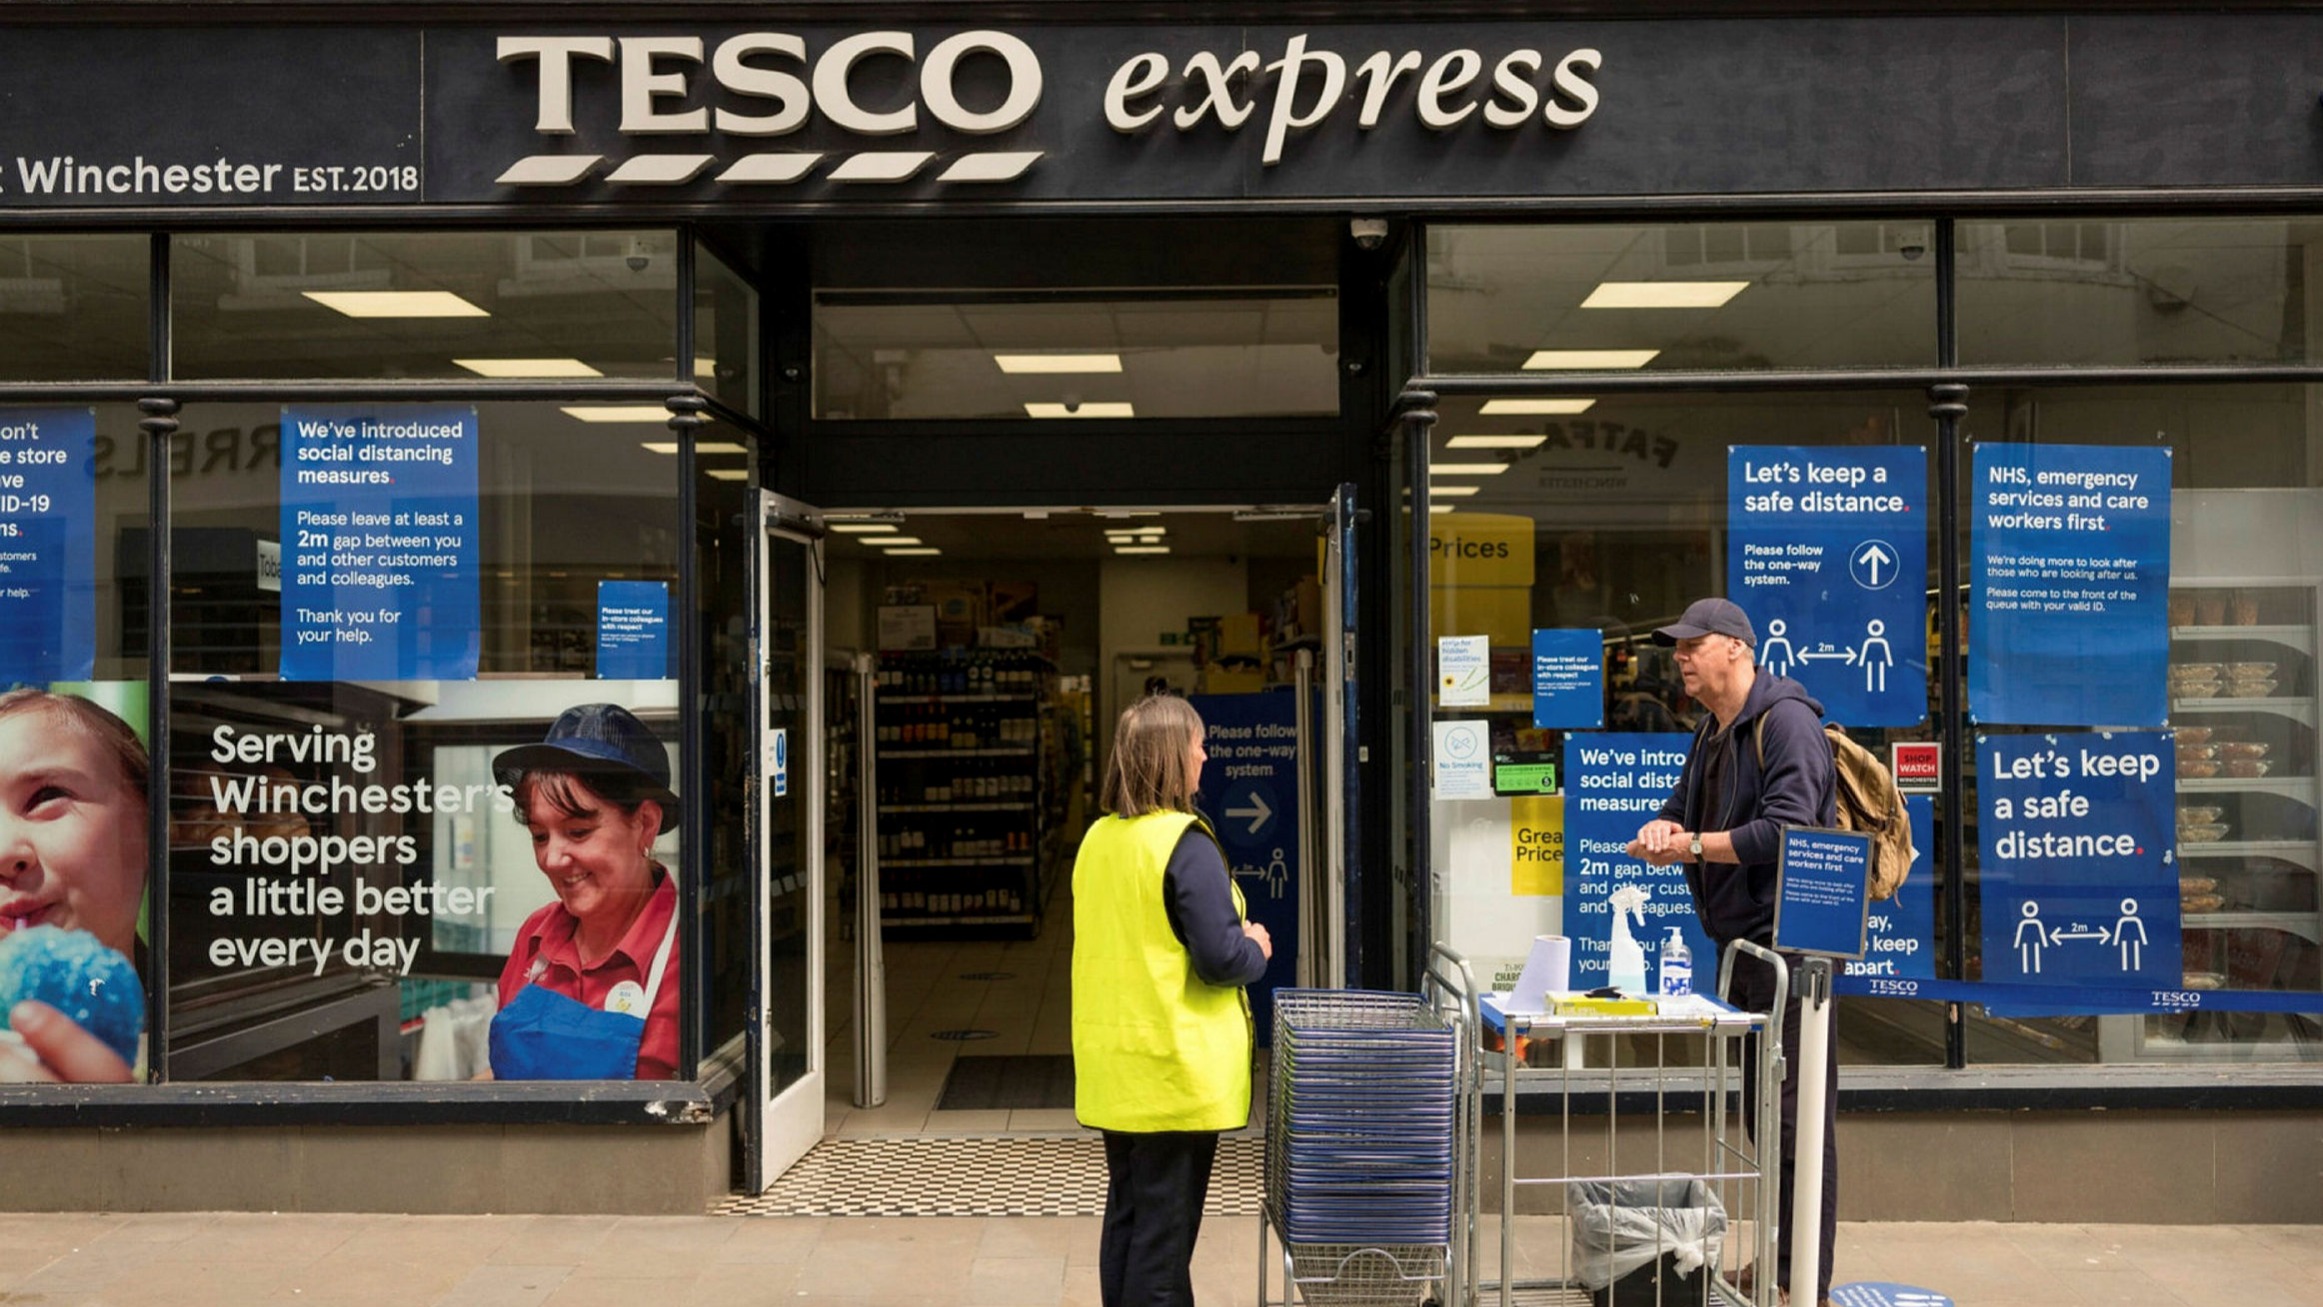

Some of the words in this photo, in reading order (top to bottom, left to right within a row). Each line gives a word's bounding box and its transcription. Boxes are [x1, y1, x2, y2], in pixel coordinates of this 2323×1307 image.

[497, 31, 1042, 136] TESCO
[1104, 33, 1602, 166] express
[17, 157, 281, 194] Winchester
[293, 166, 418, 192] EST.2018
[0, 422, 39, 440] on't
[298, 421, 356, 438] We've
[361, 422, 463, 438] introduced
[17, 447, 67, 464] store
[298, 444, 353, 461] social
[358, 444, 453, 465] distancing
[0, 475, 25, 488] ve
[298, 469, 396, 484] measures.
[1745, 462, 1800, 483] Let's
[1808, 462, 1866, 488] keep
[1873, 466, 1887, 483] a
[1989, 466, 2032, 486] NHS,
[2037, 471, 2138, 490] emergency
[1, 494, 50, 513] ID-19
[1745, 491, 1793, 512] safe
[1800, 491, 1910, 512] distance.
[1988, 490, 2064, 507] services
[2068, 492, 2103, 508] and
[2107, 495, 2149, 509] care
[298, 511, 347, 525] Please
[352, 511, 391, 525] leave
[395, 512, 410, 525] at
[414, 511, 449, 525] least
[454, 514, 463, 525] a
[1988, 512, 2063, 530] workers
[2067, 513, 2111, 531] first.
[297, 530, 328, 547] 2m
[333, 535, 360, 551] gap
[365, 533, 430, 548] between
[435, 536, 461, 551] you
[1430, 537, 1509, 558] Prices
[1744, 544, 1783, 556] Please
[1786, 543, 1823, 556] follow
[297, 552, 326, 566] and
[331, 552, 373, 566] other
[378, 553, 457, 566] customers
[1744, 559, 1765, 571] the
[1768, 561, 1821, 573] one-way
[1987, 555, 2016, 565] We're
[2018, 556, 2046, 570] doing
[2048, 558, 2075, 567] more
[2076, 557, 2088, 568] to
[2089, 557, 2110, 568] look
[2113, 557, 2138, 569] after
[297, 571, 326, 585] and
[331, 571, 414, 588] colleagues.
[1744, 574, 1790, 588] system.
[1987, 567, 2016, 577] those
[2018, 569, 2040, 578] who
[2041, 570, 2059, 578] are
[2060, 569, 2095, 582] looking
[2097, 569, 2122, 580] after
[2124, 571, 2139, 580] us.
[7, 588, 31, 600] help.
[1986, 586, 2019, 598] Please
[2020, 590, 2048, 599] come
[2050, 588, 2061, 599] to
[2062, 588, 2080, 599] the
[2081, 589, 2106, 600] front
[2107, 590, 2119, 600] of
[2120, 590, 2138, 601] the
[1986, 601, 2018, 612] queue
[2020, 601, 2042, 611] with
[2044, 603, 2066, 614] your
[2068, 601, 2091, 612] valid
[2093, 602, 2106, 612] ID.
[297, 608, 342, 623] Thank
[347, 611, 374, 626] you
[379, 608, 401, 623] for
[617, 624, 643, 632] respect
[297, 631, 331, 645] your
[336, 628, 373, 645] help.
[1818, 642, 1835, 653] 2m
[1537, 656, 1557, 664] Please
[1559, 656, 1574, 664] treat
[1565, 664, 1599, 672] colleagues
[1553, 672, 1578, 680] respect
[1209, 725, 1252, 739] Please
[1255, 723, 1298, 738] follow
[211, 724, 377, 773] Serving
[1210, 744, 1232, 758] the
[1235, 744, 1297, 759] one-way
[1580, 748, 1636, 766] We've
[1641, 749, 1687, 766] intro
[1904, 754, 1931, 763] SHOP
[1225, 764, 1274, 780] system
[1900, 764, 1935, 773] WATCH
[1994, 751, 2070, 779] Let's
[2081, 749, 2160, 783] keep
[1580, 772, 1633, 788] social
[209, 775, 514, 814] Winchester's
[1995, 797, 2012, 819] a
[2023, 789, 2089, 818] safe
[1518, 828, 1563, 844] Grea
[210, 827, 417, 875] shoppers
[1580, 839, 1627, 853] Please
[1811, 842, 1860, 855] emergency
[1996, 831, 2144, 859] distance.
[1517, 845, 1564, 862] Price
[1788, 850, 1824, 860] services
[1826, 853, 1842, 862] and
[1844, 855, 1864, 864] care
[1580, 858, 1609, 875] 2m
[1615, 864, 1642, 879] gap
[1646, 862, 1683, 876] betw
[1787, 859, 1822, 870] workers
[1579, 881, 1608, 894] and
[209, 886, 234, 916] a
[246, 877, 344, 916] little
[356, 877, 495, 916] better
[1579, 900, 1608, 913] and
[1613, 902, 1695, 917] eagues.
[1868, 915, 1893, 932] ay,
[2071, 923, 2088, 933] 2m
[209, 937, 334, 977] every
[343, 927, 421, 976] day
[1579, 937, 1612, 951] Tha
[1873, 935, 1919, 955] keep
[1579, 959, 1610, 974] your
[1844, 959, 1900, 976] apart.
[1870, 979, 1918, 991] TESCO
[2152, 991, 2201, 1003] TESCO
